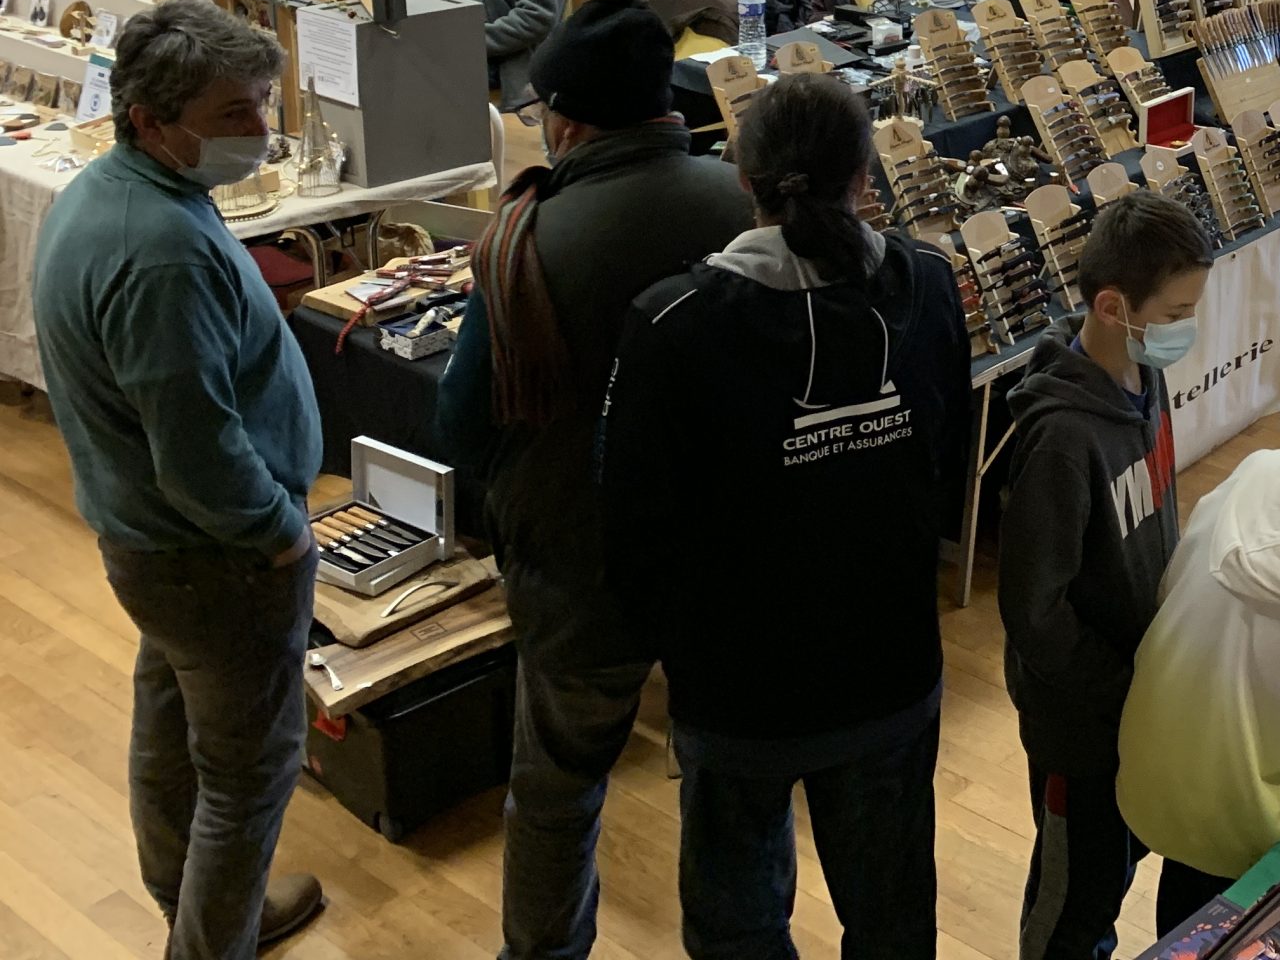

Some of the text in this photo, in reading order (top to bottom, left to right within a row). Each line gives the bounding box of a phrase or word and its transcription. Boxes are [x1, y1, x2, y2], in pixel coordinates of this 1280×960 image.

[1171, 338, 1274, 410] tellerie
[783, 409, 912, 450] CENTRE OUEST
[783, 427, 913, 467] BANQUE ET ASSURANCES
